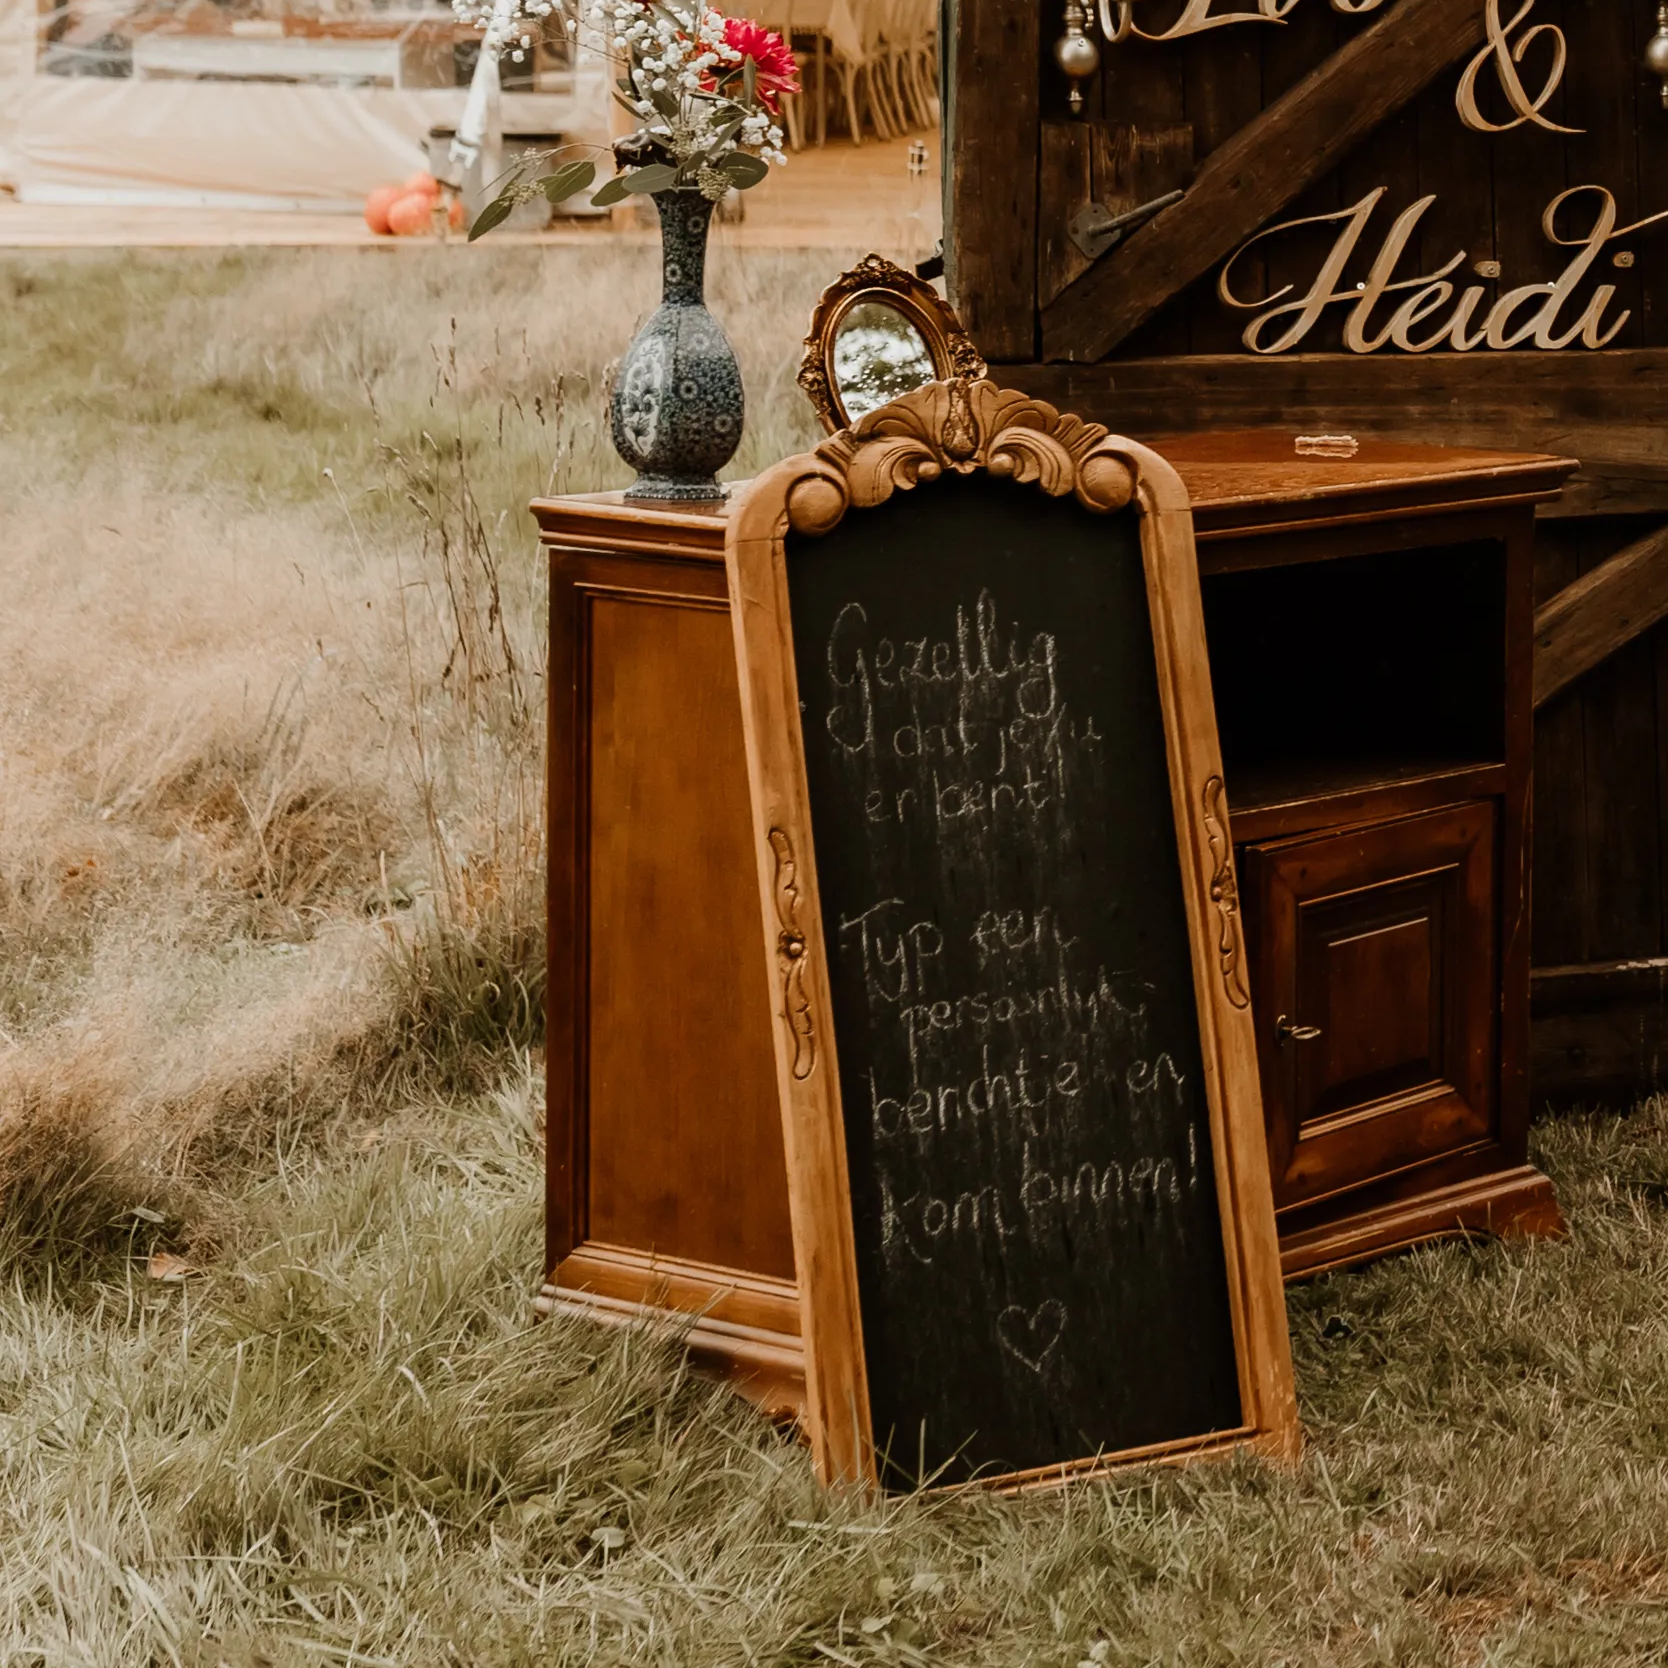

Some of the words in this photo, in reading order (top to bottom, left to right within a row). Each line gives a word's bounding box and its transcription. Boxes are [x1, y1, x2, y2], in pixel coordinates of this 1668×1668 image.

[826, 587, 1056, 753] Gezellig
[893, 700, 978, 757] dat
[864, 788, 918, 823] er
[838, 897, 944, 1003] Typ
[969, 906, 1081, 954] een
[1126, 1052, 1186, 1096] en
[1020, 1122, 1198, 1213] binnen!
